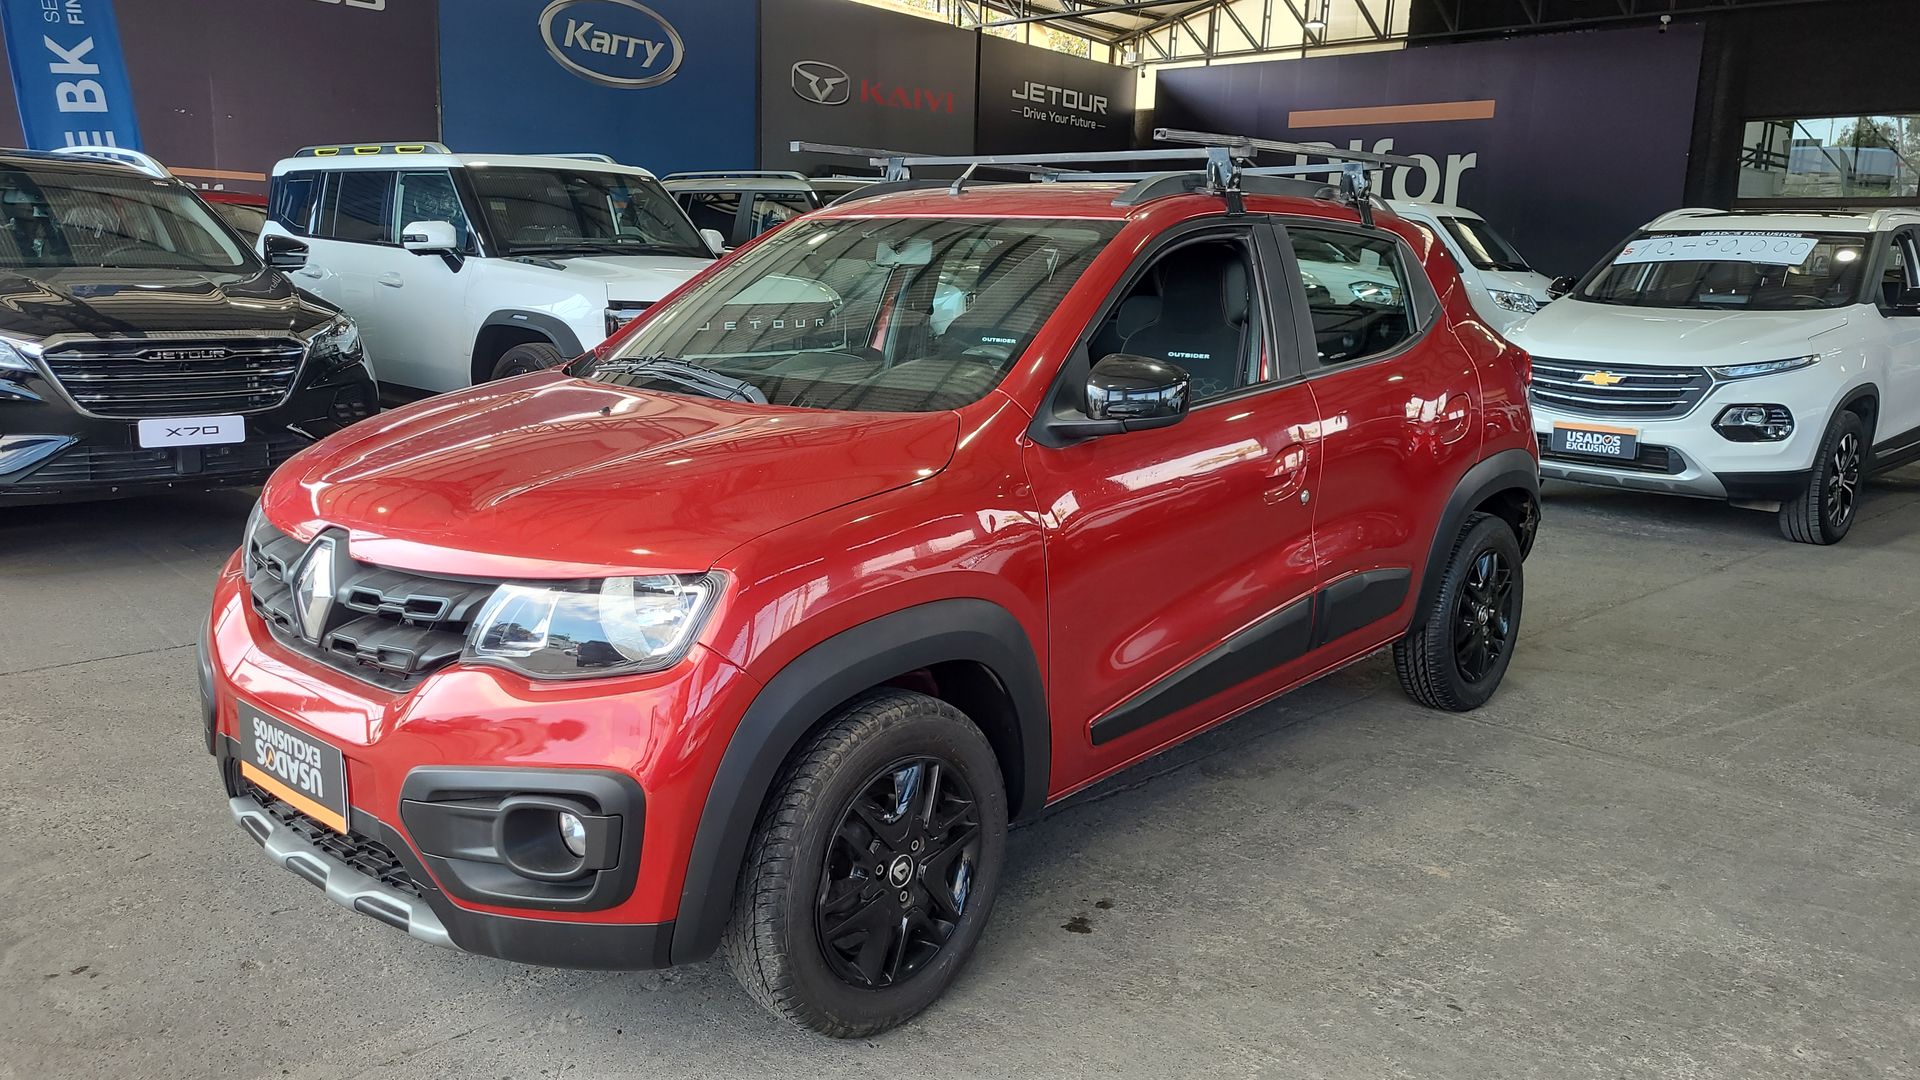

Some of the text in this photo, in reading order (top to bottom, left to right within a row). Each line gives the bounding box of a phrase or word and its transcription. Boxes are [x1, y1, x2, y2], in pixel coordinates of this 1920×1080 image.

[564, 18, 665, 68] Karry
[1012, 81, 1108, 115] JETOUR
[1023, 106, 1096, 129] Drive Your Future
[697, 318, 825, 331] JETOUR
[981, 336, 1017, 344] OUTSIDER
[148, 350, 226, 360] JETOUR
[1167, 351, 1210, 360] OUTSIDER
[166, 425, 219, 437] X70
[1566, 430, 1621, 446] USADOS
[1565, 441, 1621, 455] EXCLUSIVOS
[252, 716, 322, 769] EXCLUSIVOS
[255, 738, 324, 798] USADOS
